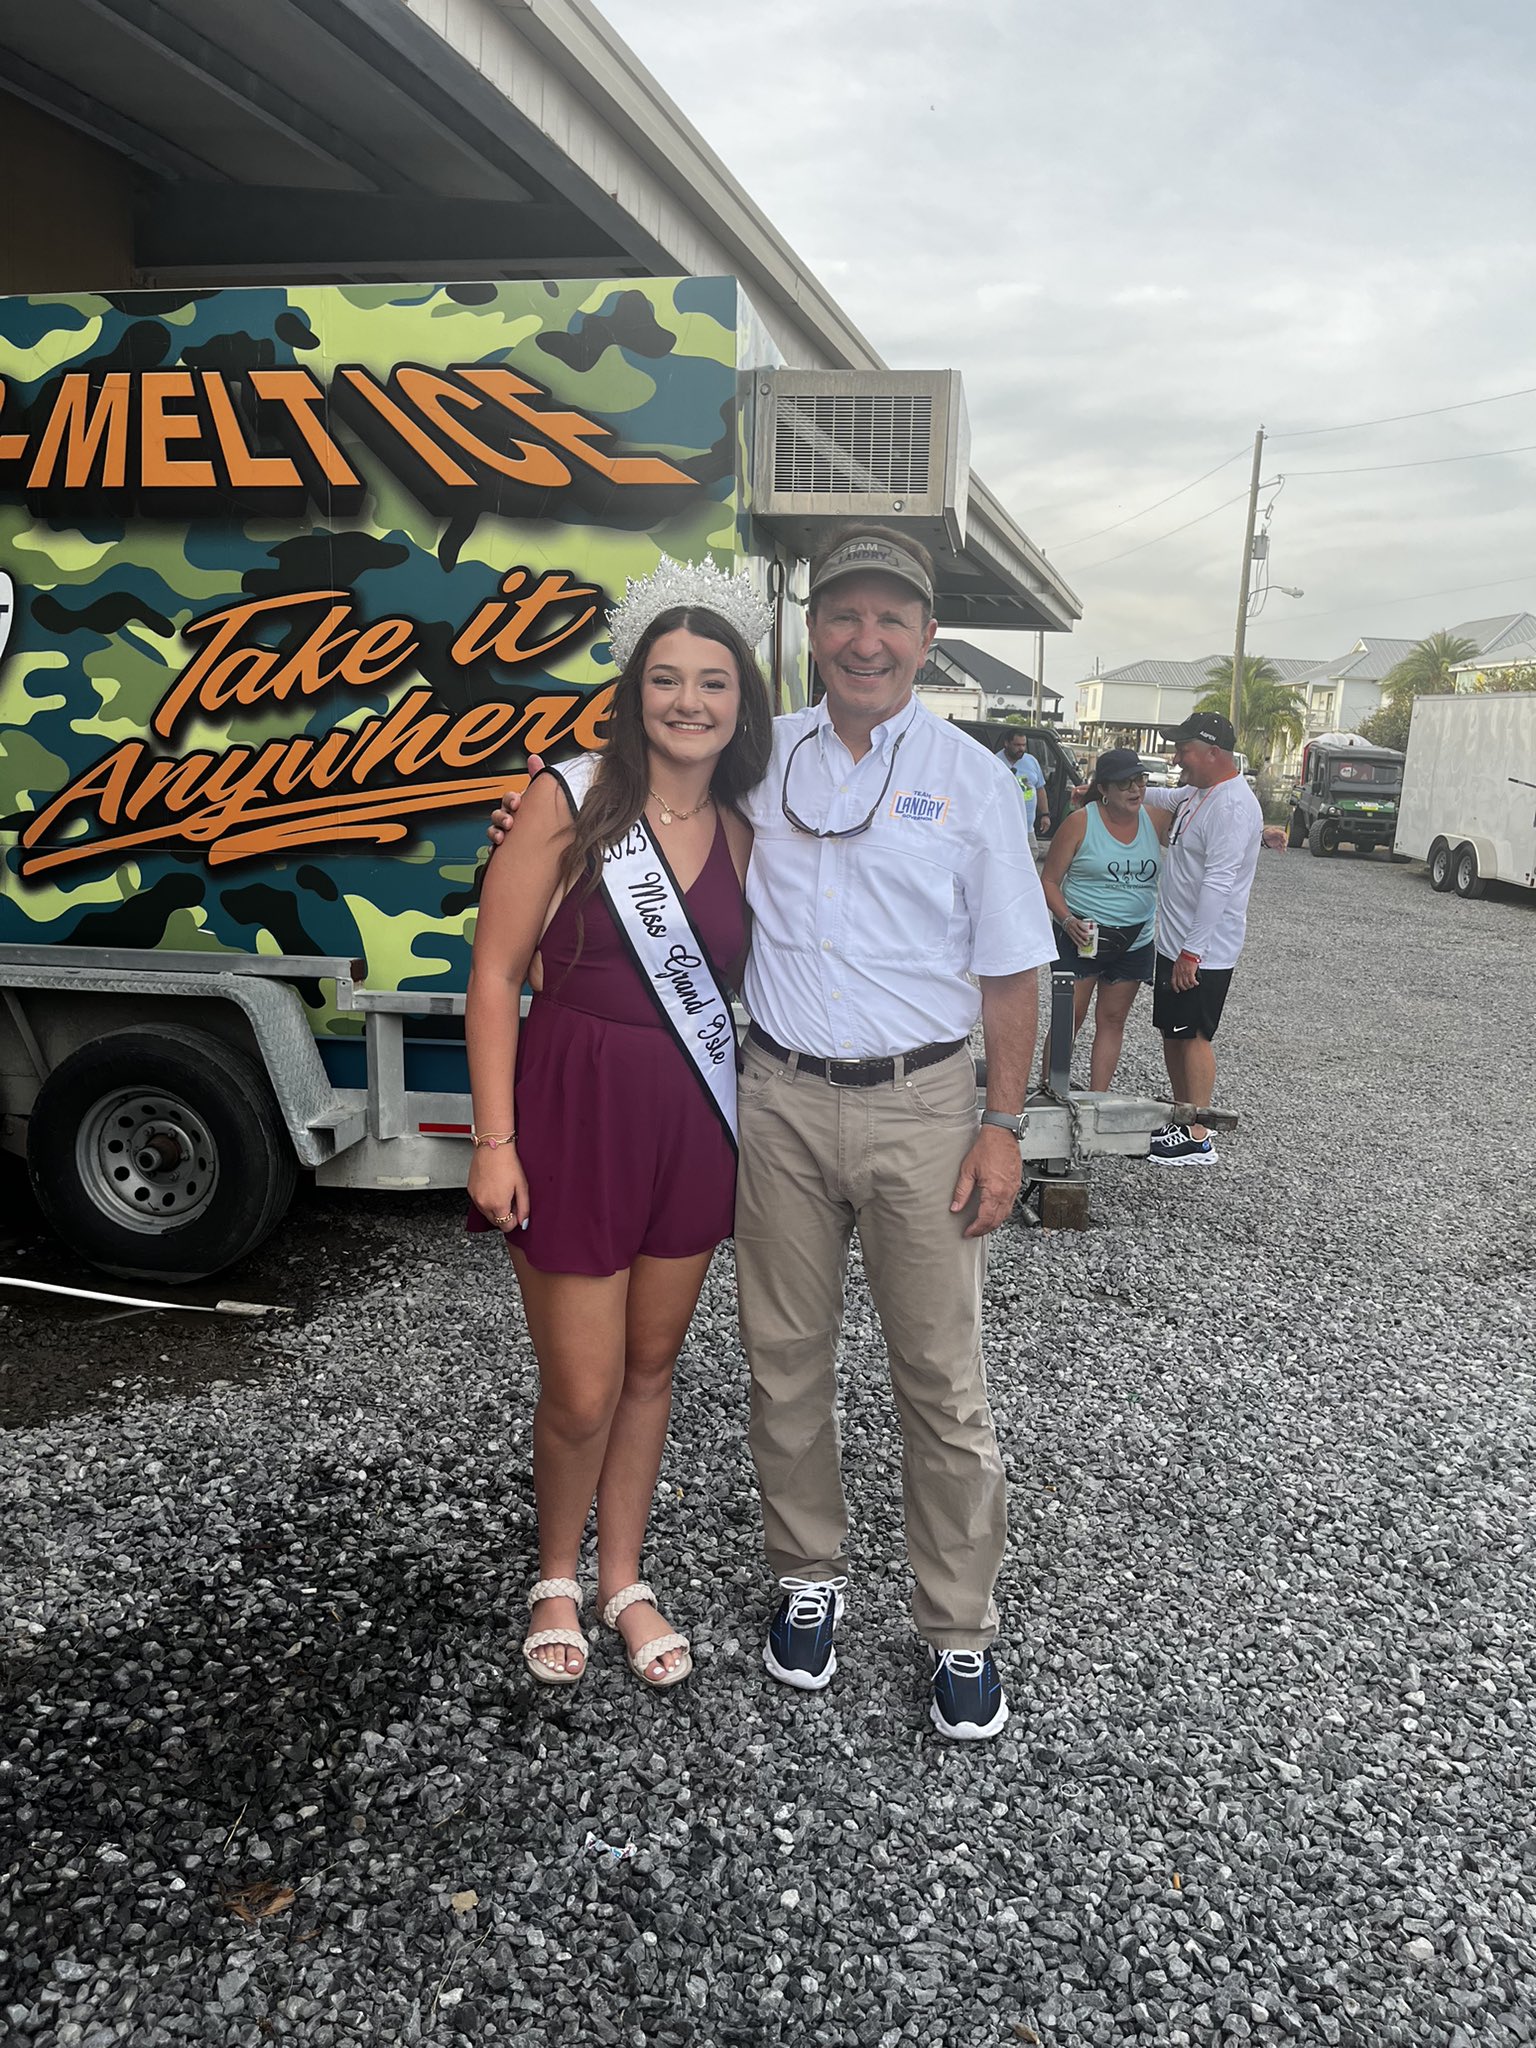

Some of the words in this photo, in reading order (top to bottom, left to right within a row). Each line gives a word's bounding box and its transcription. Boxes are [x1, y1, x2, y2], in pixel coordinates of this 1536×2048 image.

[0, 369, 361, 488] -MELT
[340, 368, 701, 487] ICE
[838, 551, 888, 564] LANDRY
[841, 543, 878, 553] TEAM
[153, 590, 419, 738] Take
[450, 571, 598, 665] it
[23, 683, 618, 848] Anywhere
[913, 790, 932, 799] TEAM
[895, 796, 945, 819] LANDRY
[628, 872, 668, 938] Miss
[654, 944, 716, 1016] Grand
[698, 1013, 731, 1065] Isle
